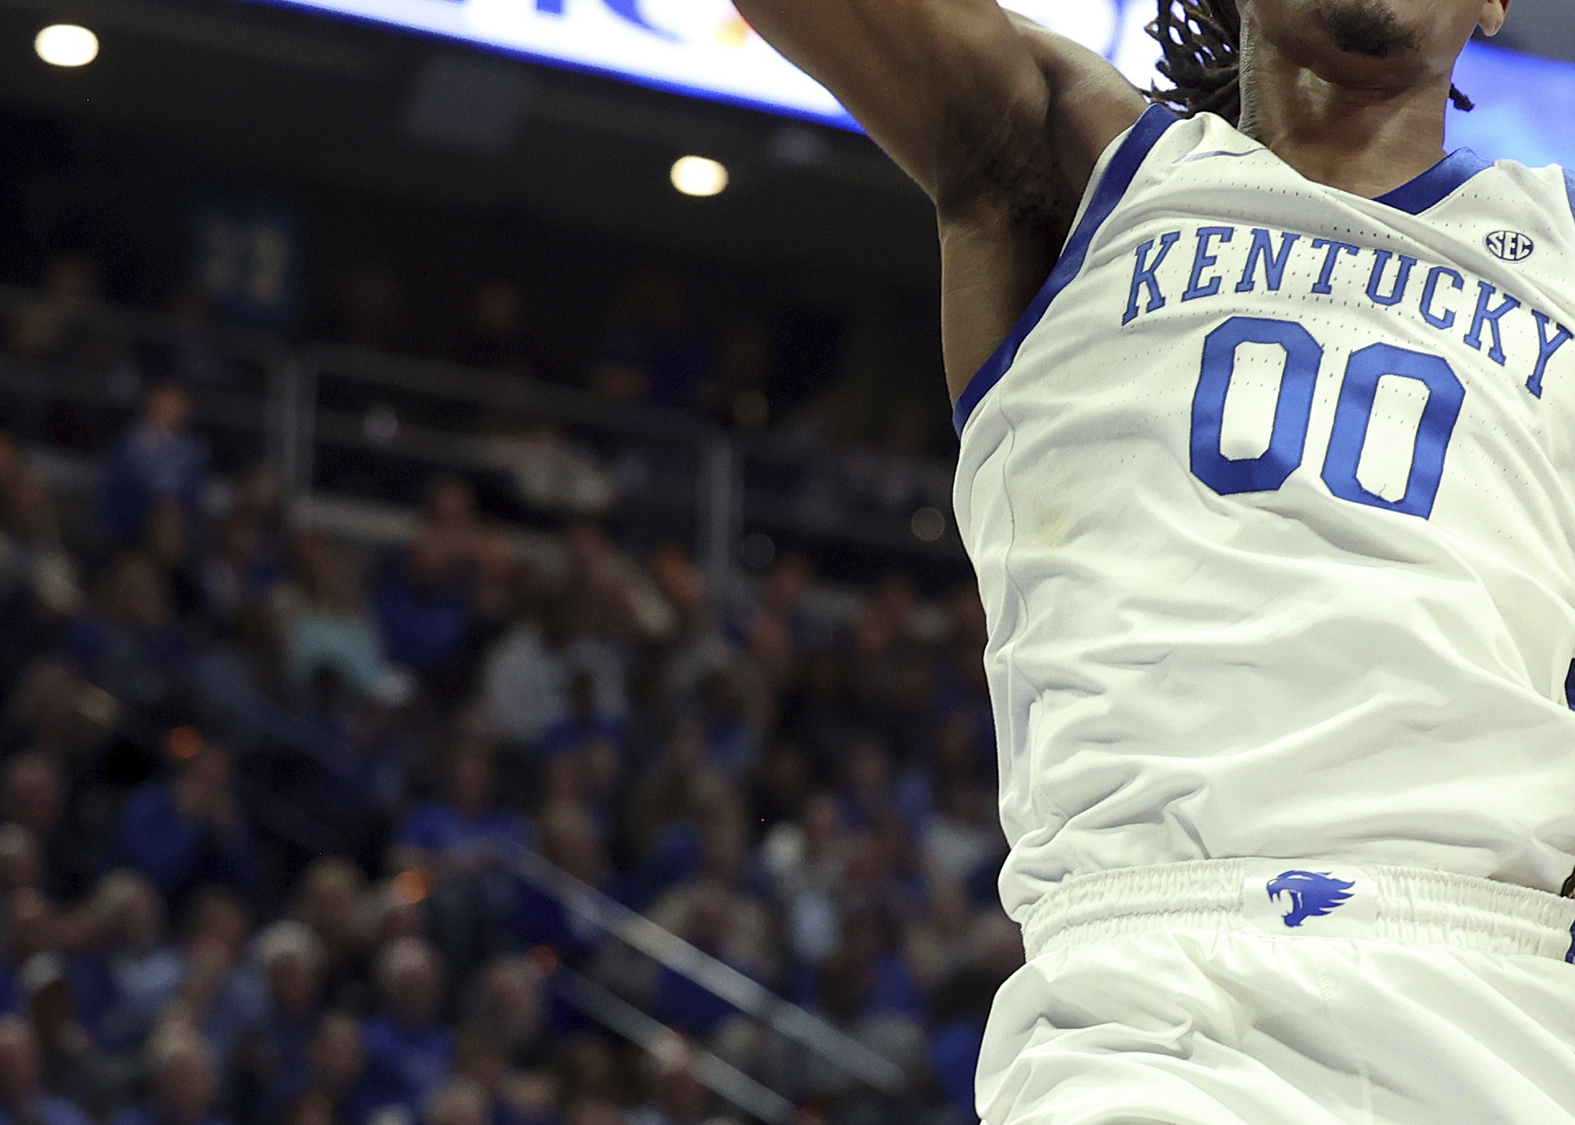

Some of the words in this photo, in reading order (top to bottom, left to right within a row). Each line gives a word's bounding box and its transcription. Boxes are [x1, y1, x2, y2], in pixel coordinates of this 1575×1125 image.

[1122, 226, 1574, 399] KENTUCKY
[1486, 230, 1534, 261] SEC
[1189, 316, 1466, 521] 00
